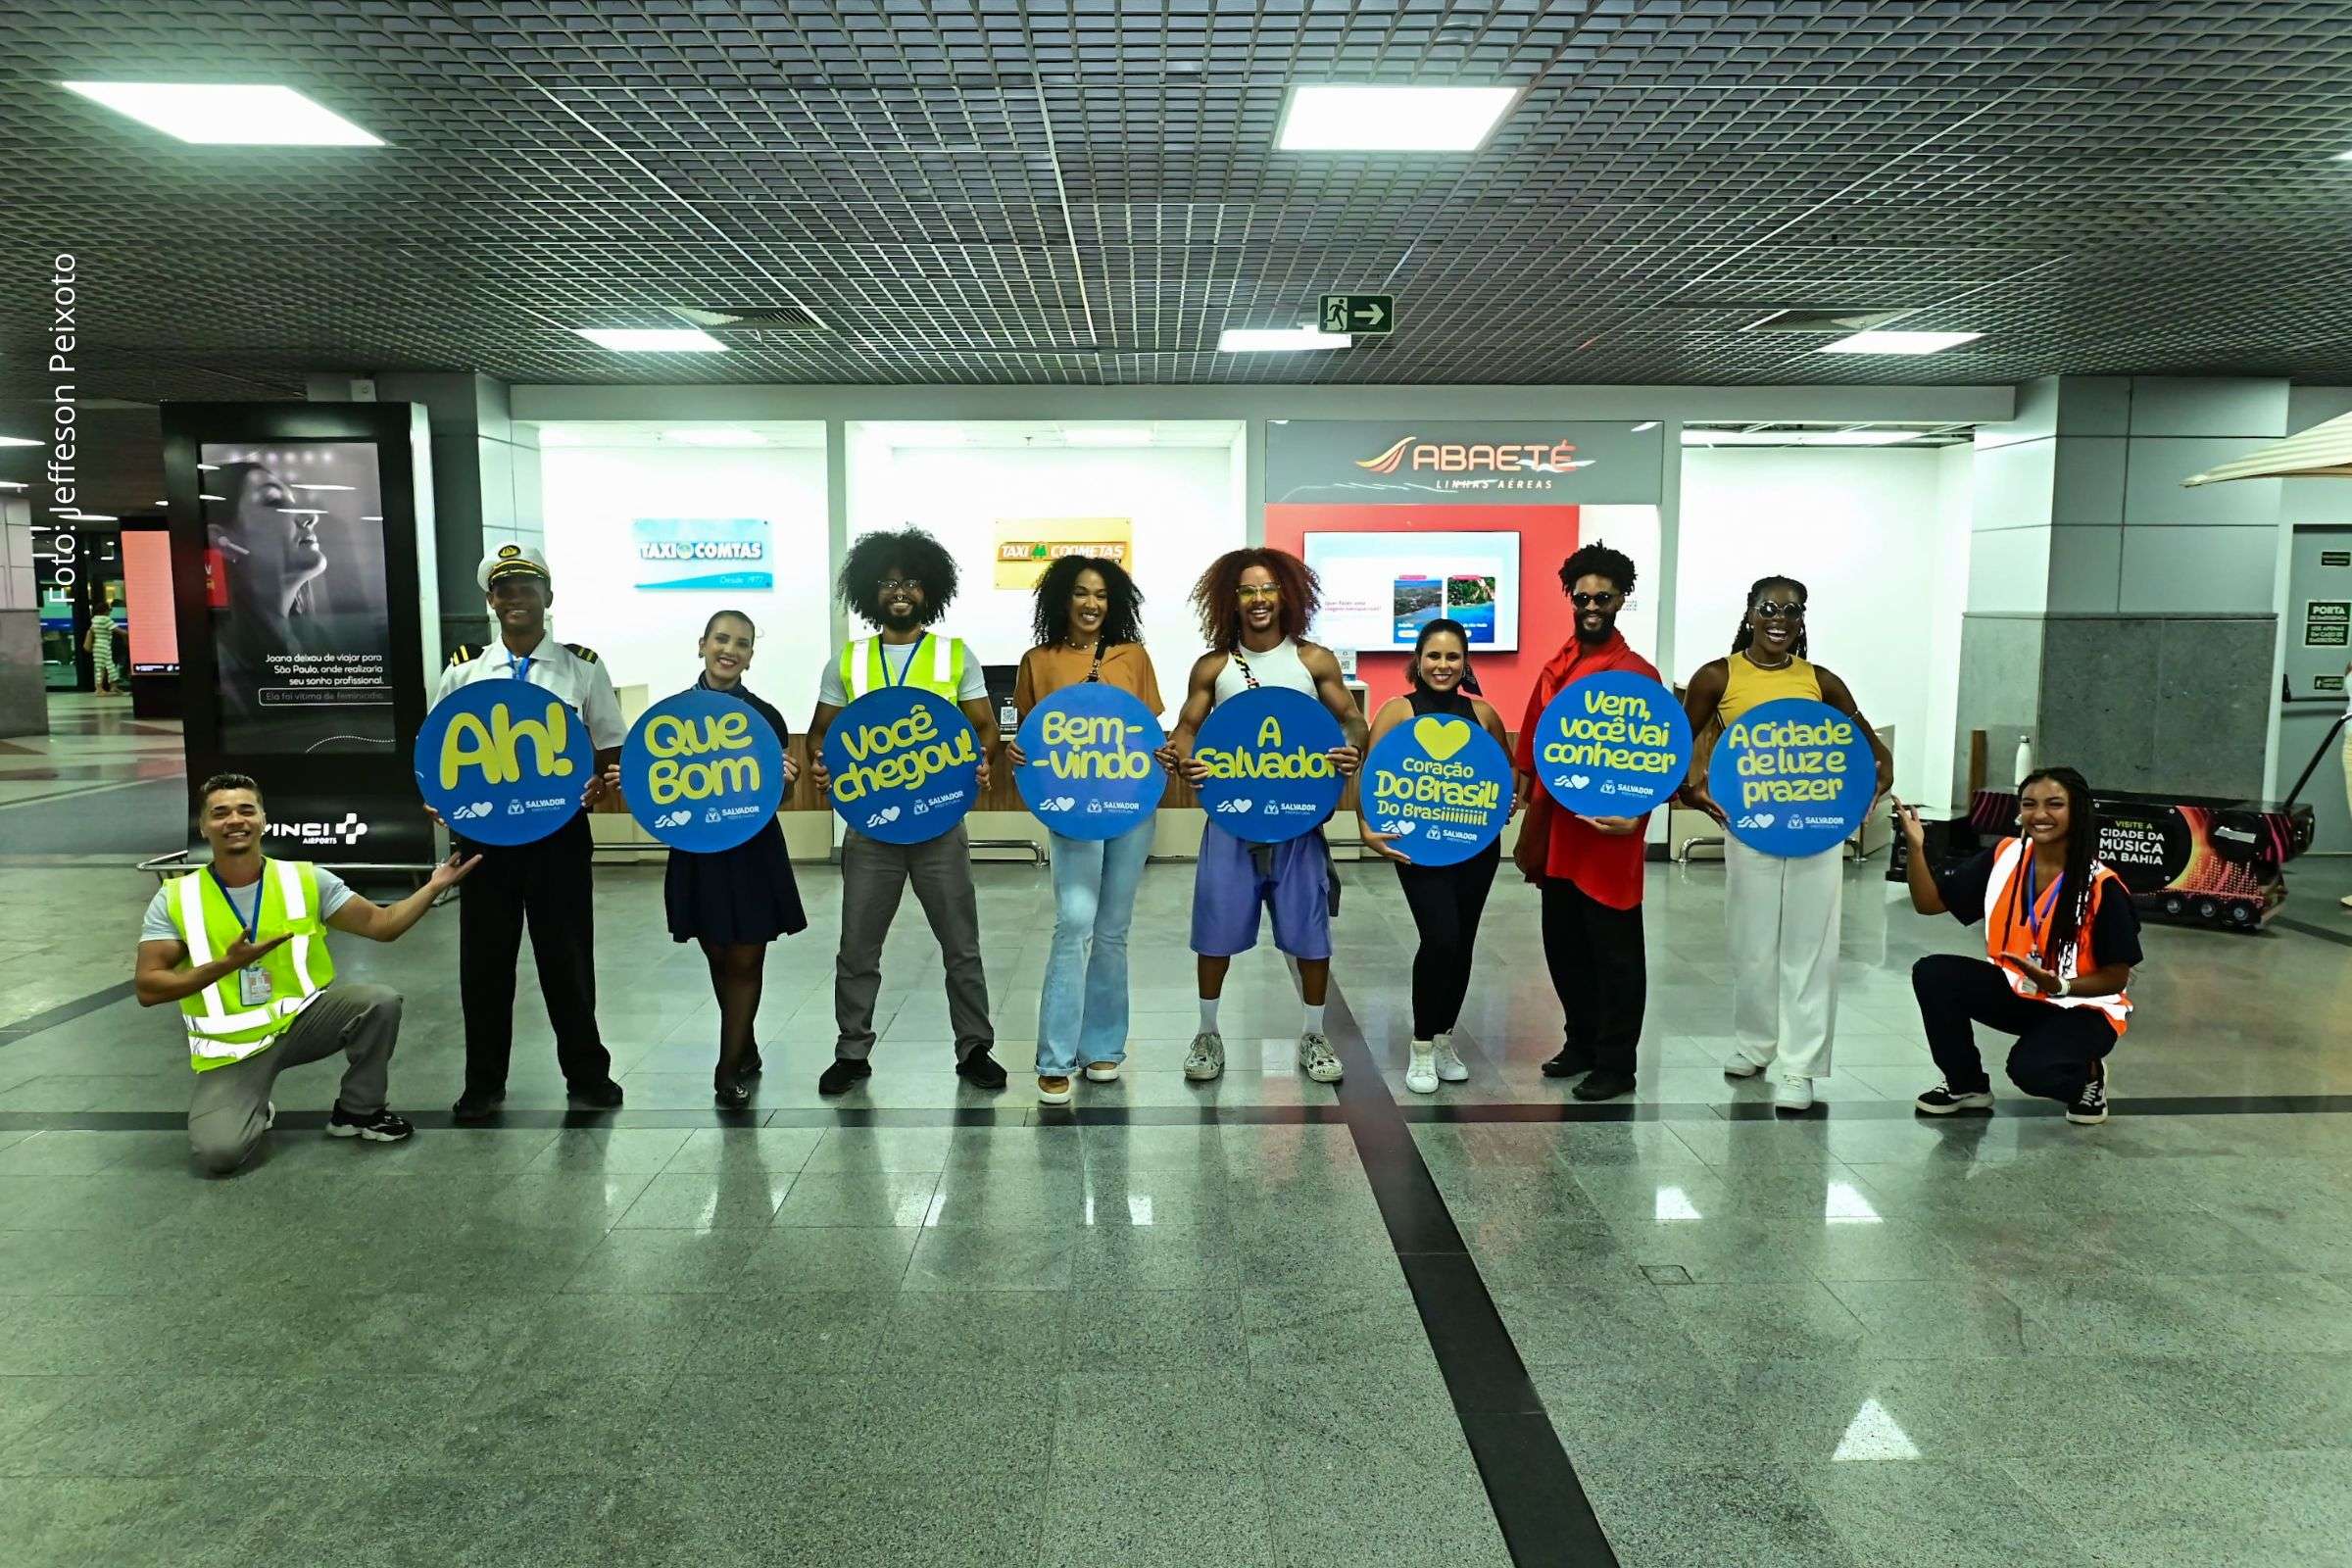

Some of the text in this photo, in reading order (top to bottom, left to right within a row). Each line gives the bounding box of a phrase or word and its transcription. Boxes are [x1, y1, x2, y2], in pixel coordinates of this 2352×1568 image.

[1412, 438, 1578, 472] ABAETÉ
[1497, 477, 1553, 490] AÉREAS
[641, 541, 762, 560] TAXI COMTAS
[1002, 544, 1125, 559] TAXI COOMETAS
[2313, 606, 2346, 615] PORTA
[266, 653, 382, 664] Joana deixou de viajar para
[274, 664, 383, 674] São Paulo, onde realizaria
[306, 676, 332, 685] sonho
[334, 675, 384, 686] profissional.
[266, 692, 280, 701] Ela
[282, 692, 293, 701] foi
[1584, 690, 1651, 721] Vem,
[644, 711, 753, 759] Que
[841, 704, 939, 761] Você
[1042, 710, 1144, 746] Bem-
[1257, 715, 1283, 748] A
[1560, 716, 1671, 747] você vai
[1728, 723, 1750, 750] A
[440, 702, 573, 791] Ah!
[833, 728, 978, 803] chegou!
[1032, 743, 1152, 780] -vindo
[1195, 745, 1336, 779] Salvador
[1544, 741, 1677, 774] conhecer
[1737, 748, 1847, 776] de luz e
[1402, 757, 1474, 780] Coração
[1373, 770, 1414, 800] Do
[1617, 783, 1654, 796] SALVADOR
[1742, 778, 1843, 809] prazer
[525, 798, 565, 808] SALVADOR
[928, 790, 964, 807] SALVADOR
[1102, 801, 1140, 810] SALVADOR
[1280, 803, 1317, 812] SALVADOR
[721, 806, 760, 817] SALVADOR
[1376, 800, 1399, 816] Do
[1805, 816, 1844, 825] SALVADOR
[2115, 820, 2144, 830] VISITE
[1443, 829, 1478, 842] SALVADOR
[2100, 827, 2165, 842] CIDADE DA
[2099, 834, 2164, 855] MÚSICA
[2098, 850, 2164, 865] DA BAHIA
